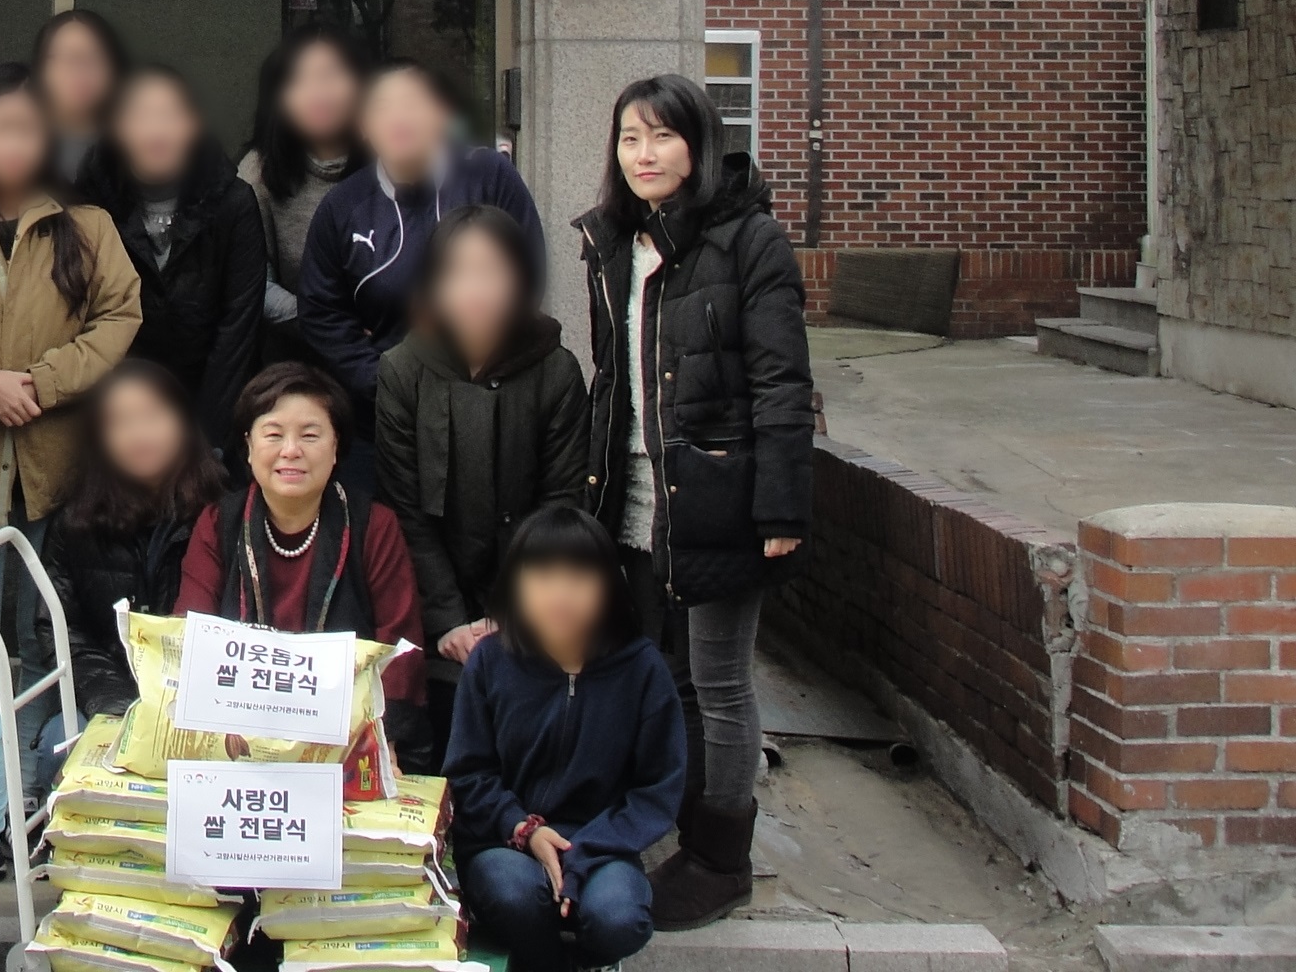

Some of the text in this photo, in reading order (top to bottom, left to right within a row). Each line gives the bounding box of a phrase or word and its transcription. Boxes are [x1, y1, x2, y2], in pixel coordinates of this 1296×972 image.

[225, 640, 313, 671] 이웃돕기
[216, 664, 318, 696] 쌀 전달식
[226, 700, 319, 717] 고양시일산서구선거관리위원회
[221, 788, 289, 813] 사랑의
[203, 815, 306, 842] 쌀 전달식
[216, 852, 310, 863] 고양시일산서구선거관리위원회
